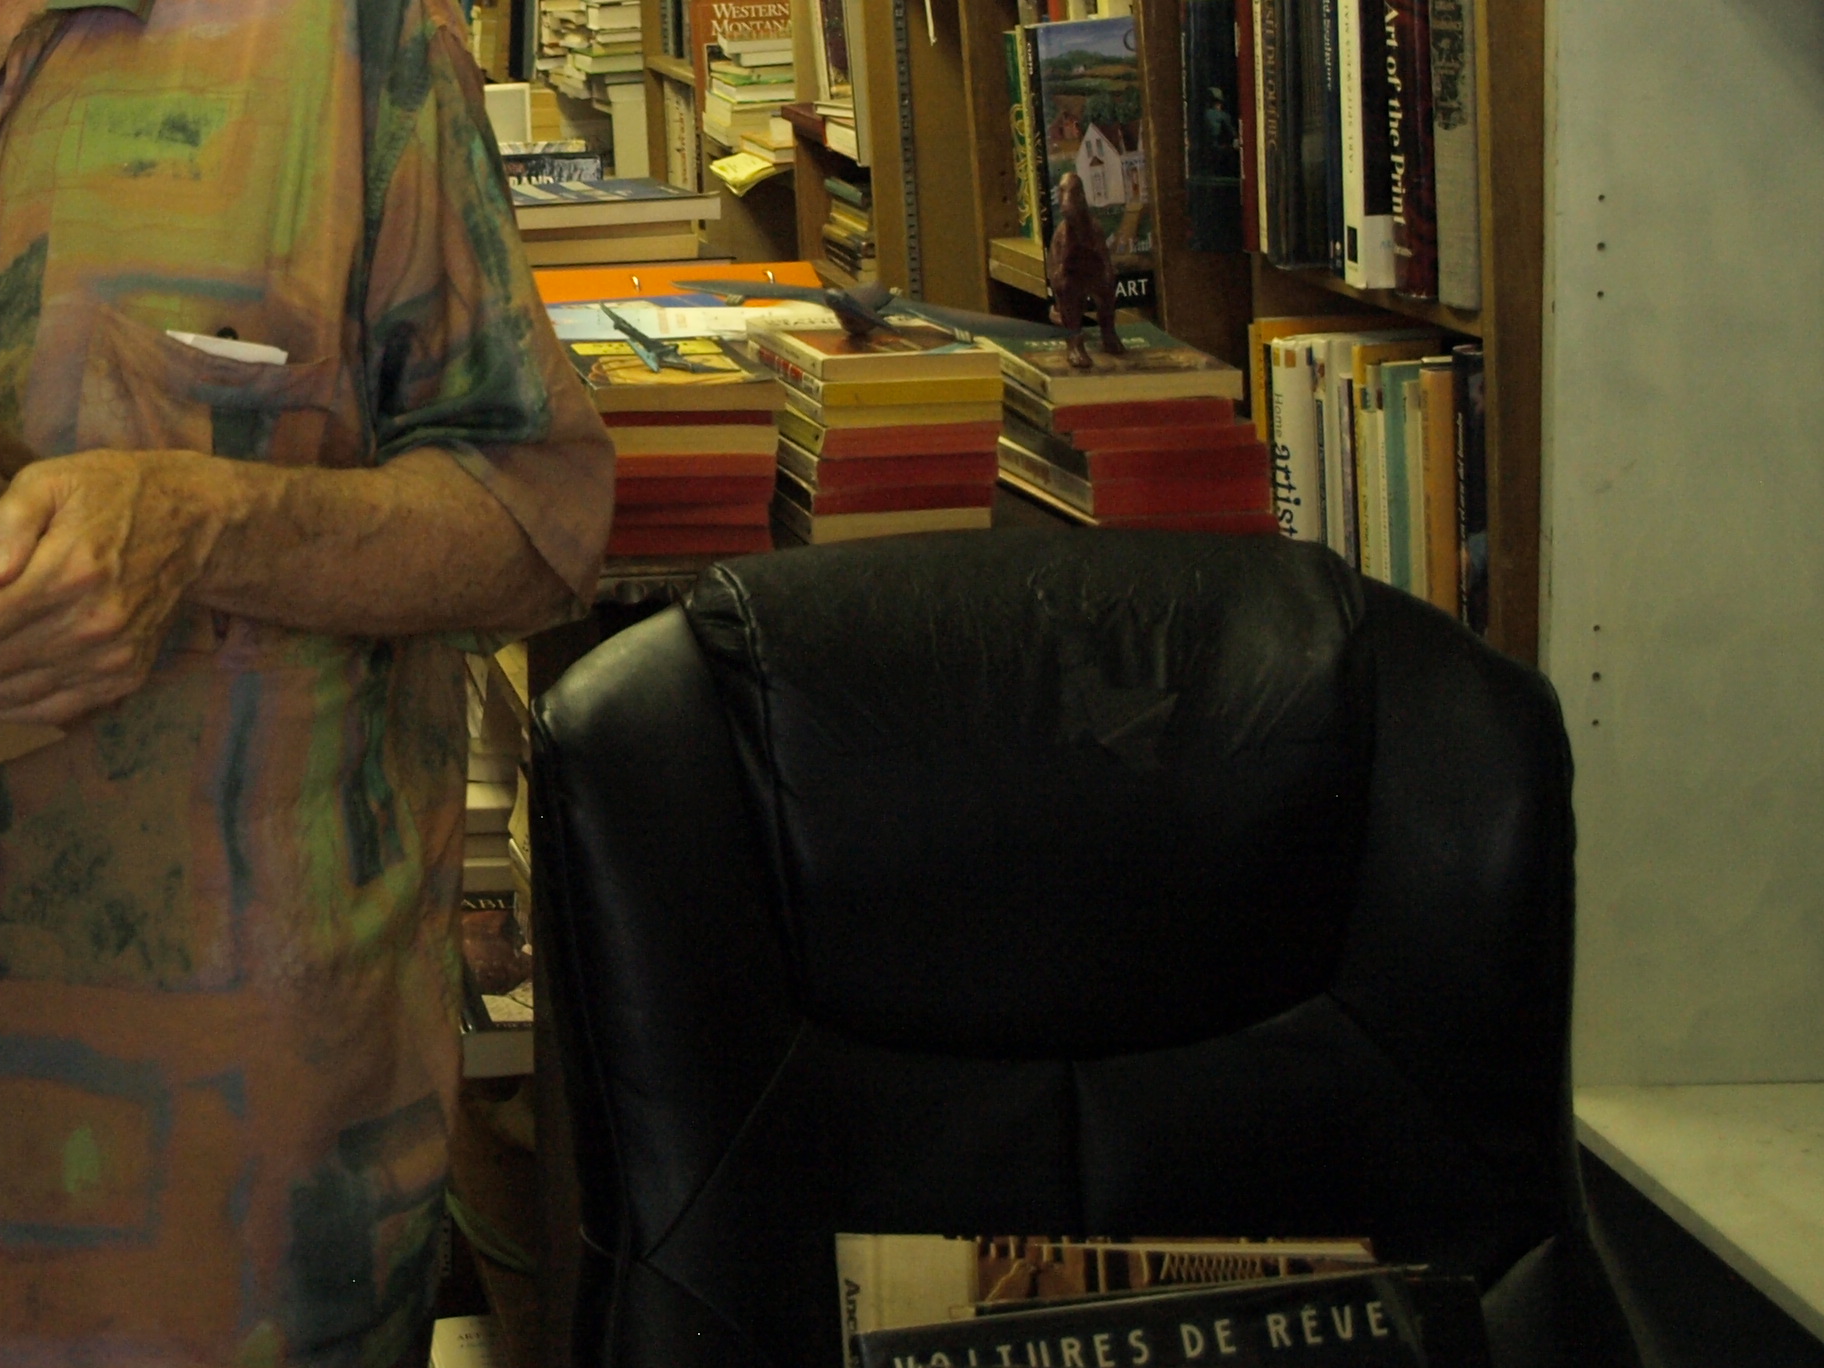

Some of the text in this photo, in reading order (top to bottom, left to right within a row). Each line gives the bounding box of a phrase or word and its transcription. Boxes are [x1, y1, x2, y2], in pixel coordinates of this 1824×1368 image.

[710, 19, 792, 37] MONTANA
[712, 2, 790, 19] WESTERN
[1383, 1, 1400, 47] Art
[1265, 44, 1276, 75] DU
[1386, 55, 1402, 91] of
[1388, 97, 1403, 147] the
[1390, 153, 1407, 225] Print
[1114, 278, 1148, 298] ART
[1274, 393, 1284, 438] Home
[1273, 444, 1302, 537] artist
[843, 1278, 861, 1335] Anc
[1180, 1318, 1236, 1360] DE
[1268, 1299, 1389, 1348] RÊVE
